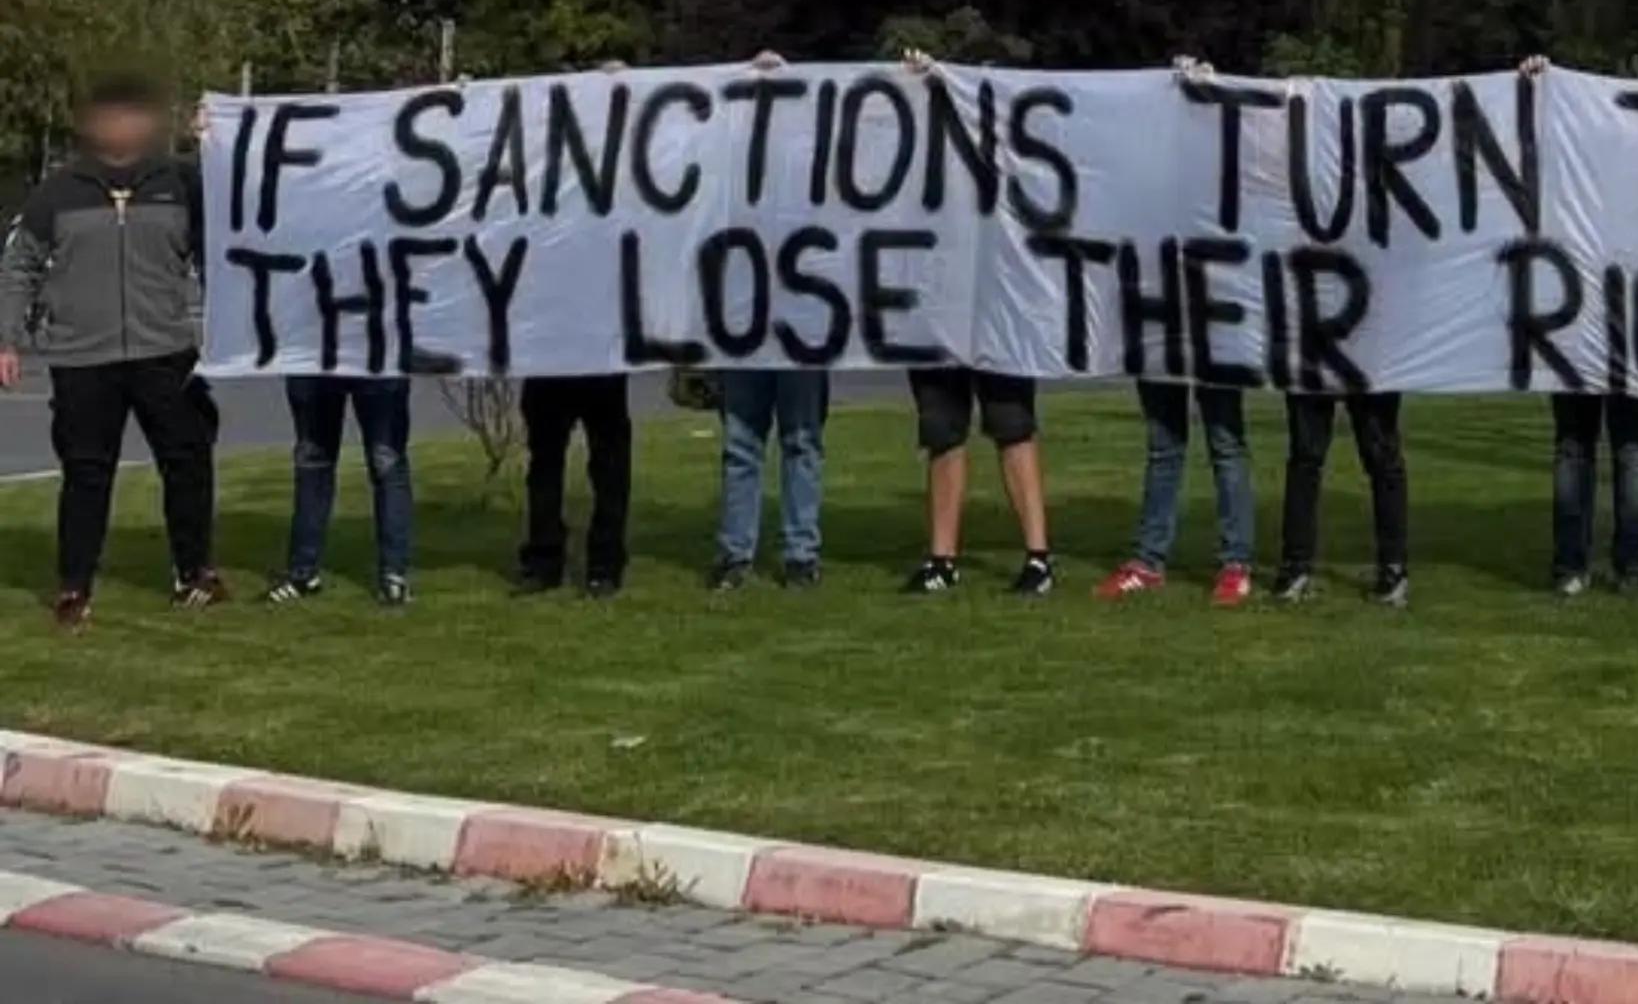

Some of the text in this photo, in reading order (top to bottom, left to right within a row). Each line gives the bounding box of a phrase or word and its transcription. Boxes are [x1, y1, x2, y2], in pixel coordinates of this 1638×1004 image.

[230, 103, 340, 234] IF
[383, 74, 1078, 230] SANCTIONS
[1180, 78, 1540, 249] TURN
[227, 235, 529, 376] THEY
[620, 226, 948, 366] LOSE
[1024, 235, 1374, 393] THEIR
